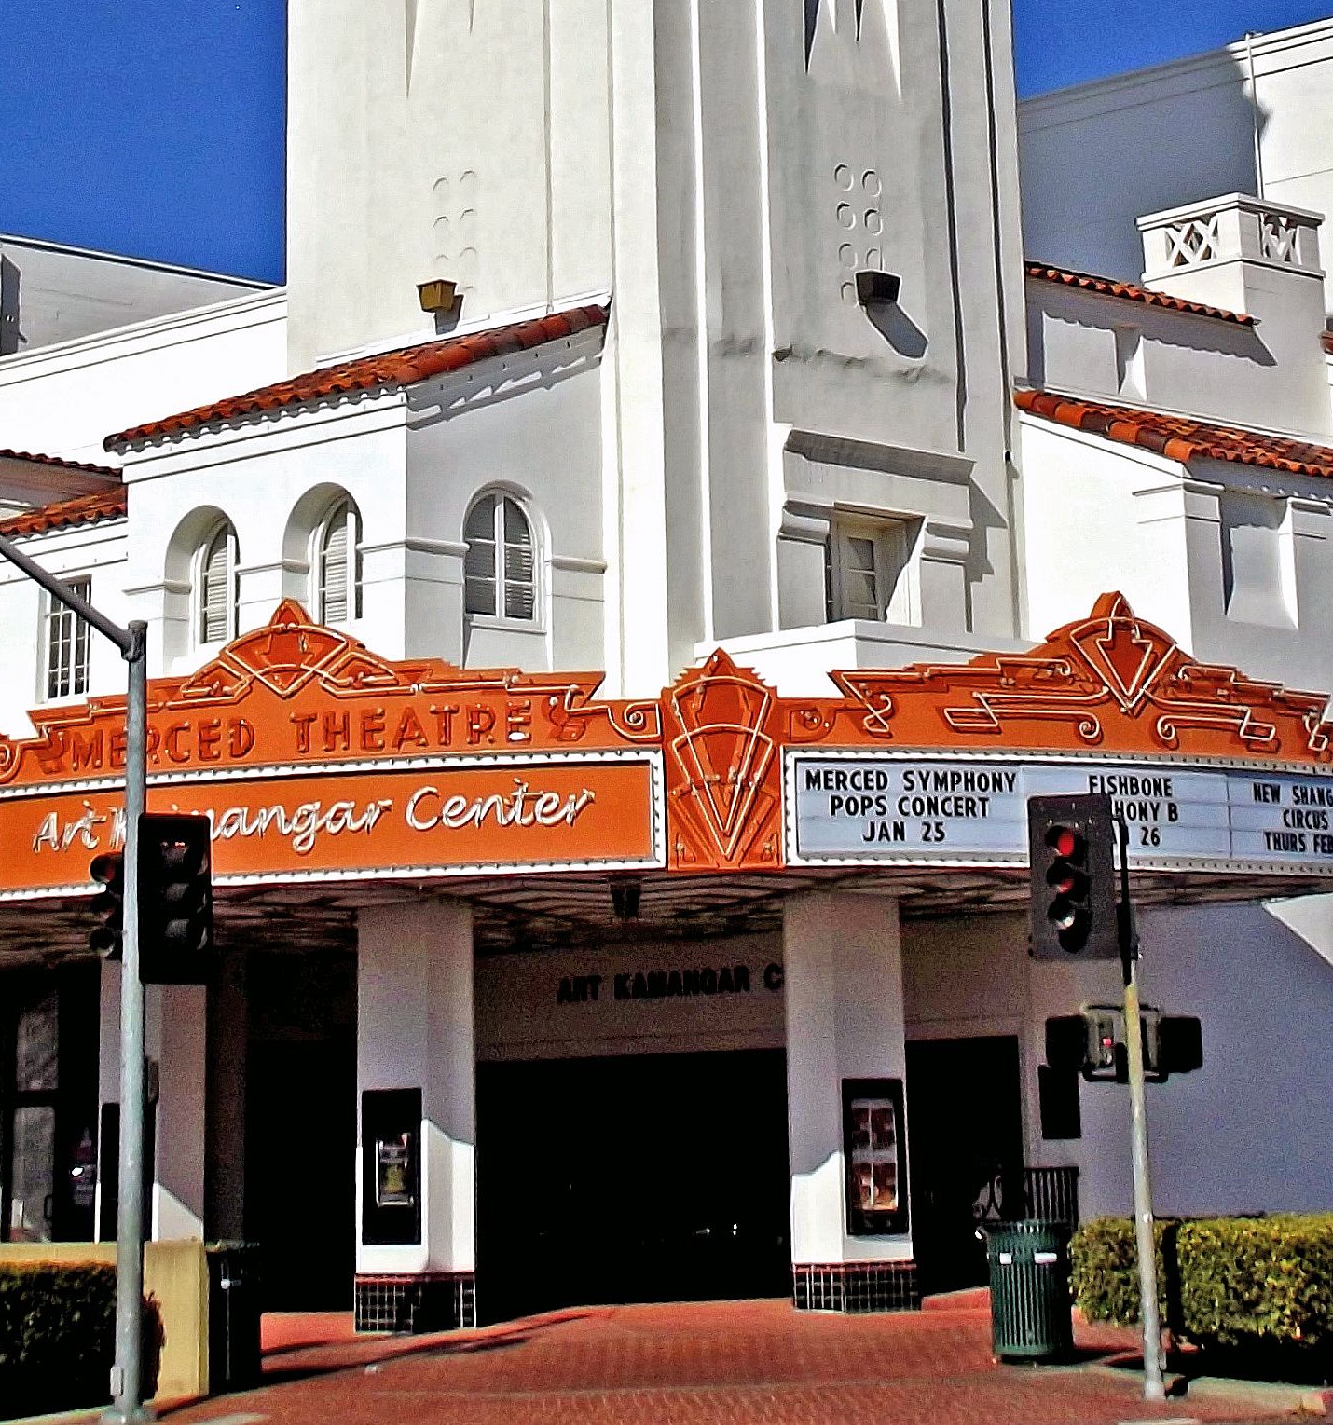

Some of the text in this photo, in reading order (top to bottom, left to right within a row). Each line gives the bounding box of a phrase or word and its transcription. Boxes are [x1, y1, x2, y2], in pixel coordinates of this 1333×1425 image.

[72, 699, 533, 771] MERCED THEATRE
[805, 769, 1016, 793] MERCED SYMPHONY
[1089, 775, 1173, 797] FISHBONE
[1253, 782, 1281, 803] NEW
[32, 778, 596, 856] Art Kangar Center
[830, 795, 990, 818] POPS CONCERT
[1114, 801, 1178, 822] HONY B
[1283, 809, 1328, 830] CIRCUS
[863, 821, 946, 842] JAN 25
[1141, 826, 1161, 847] 26
[1265, 832, 1306, 852] THURS
[557, 974, 602, 1004] ART
